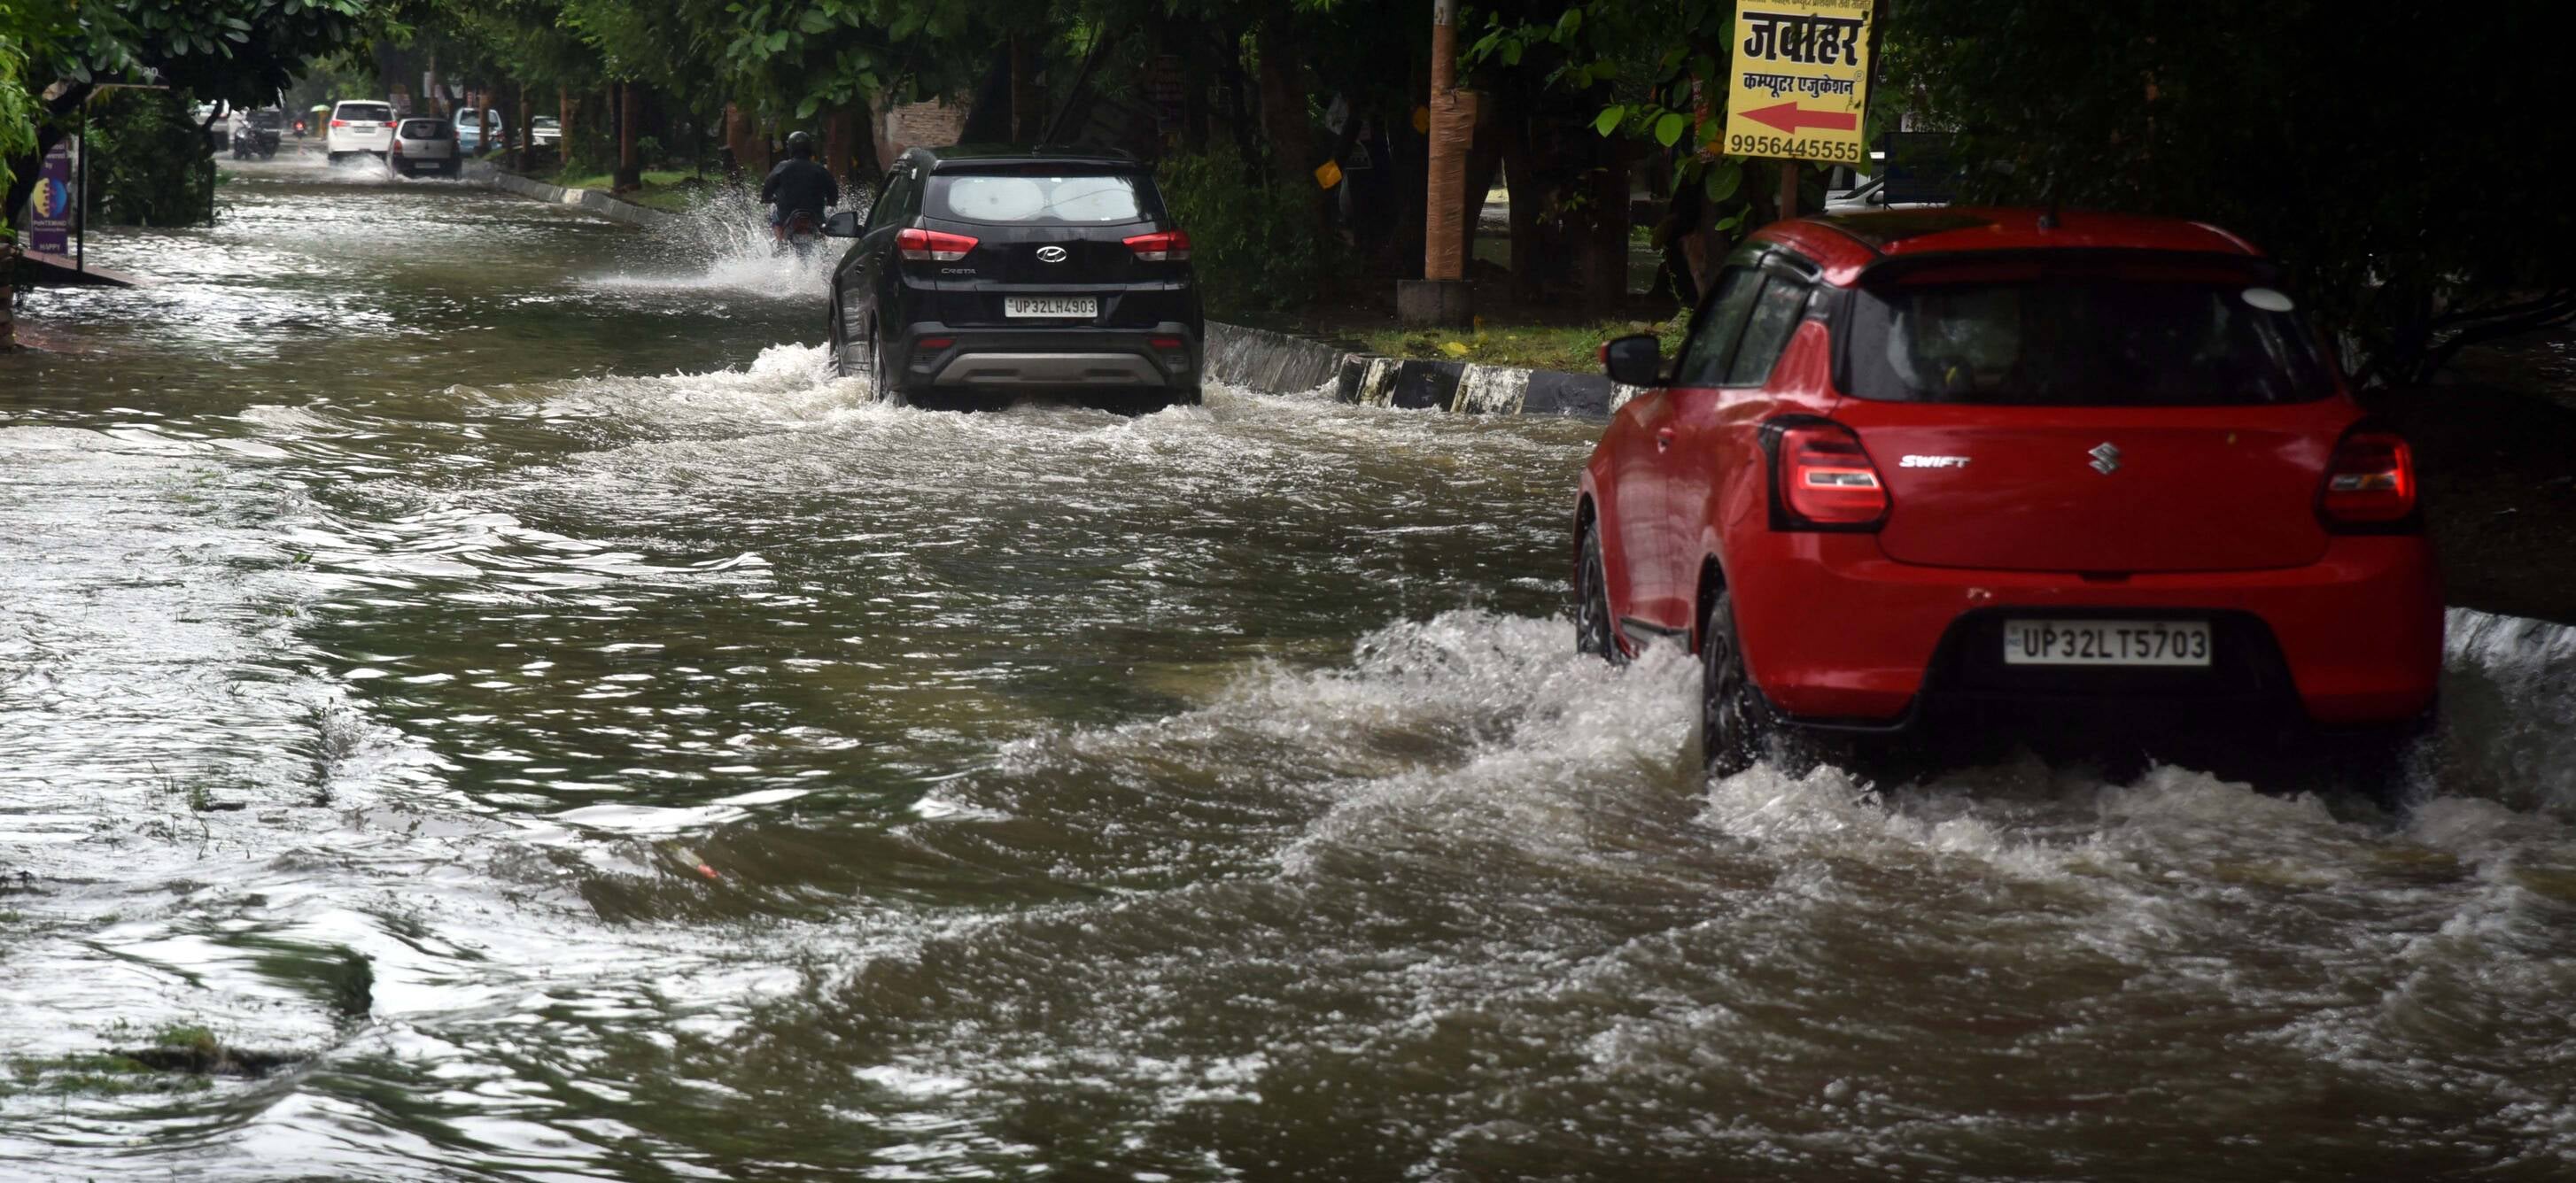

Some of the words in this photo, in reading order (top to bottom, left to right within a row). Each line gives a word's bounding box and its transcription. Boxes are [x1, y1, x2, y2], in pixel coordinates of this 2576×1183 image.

[1742, 12, 1864, 66] जवाहर
[1743, 73, 1796, 97] कम्प्यूटर
[1797, 74, 1855, 97] एजुकेशन
[1731, 134, 1858, 161] 9956445555
[1015, 300, 1096, 313] UP32LH4903
[1898, 454, 1972, 468] SWIFT
[2023, 629, 2207, 658] UP32LT5703
